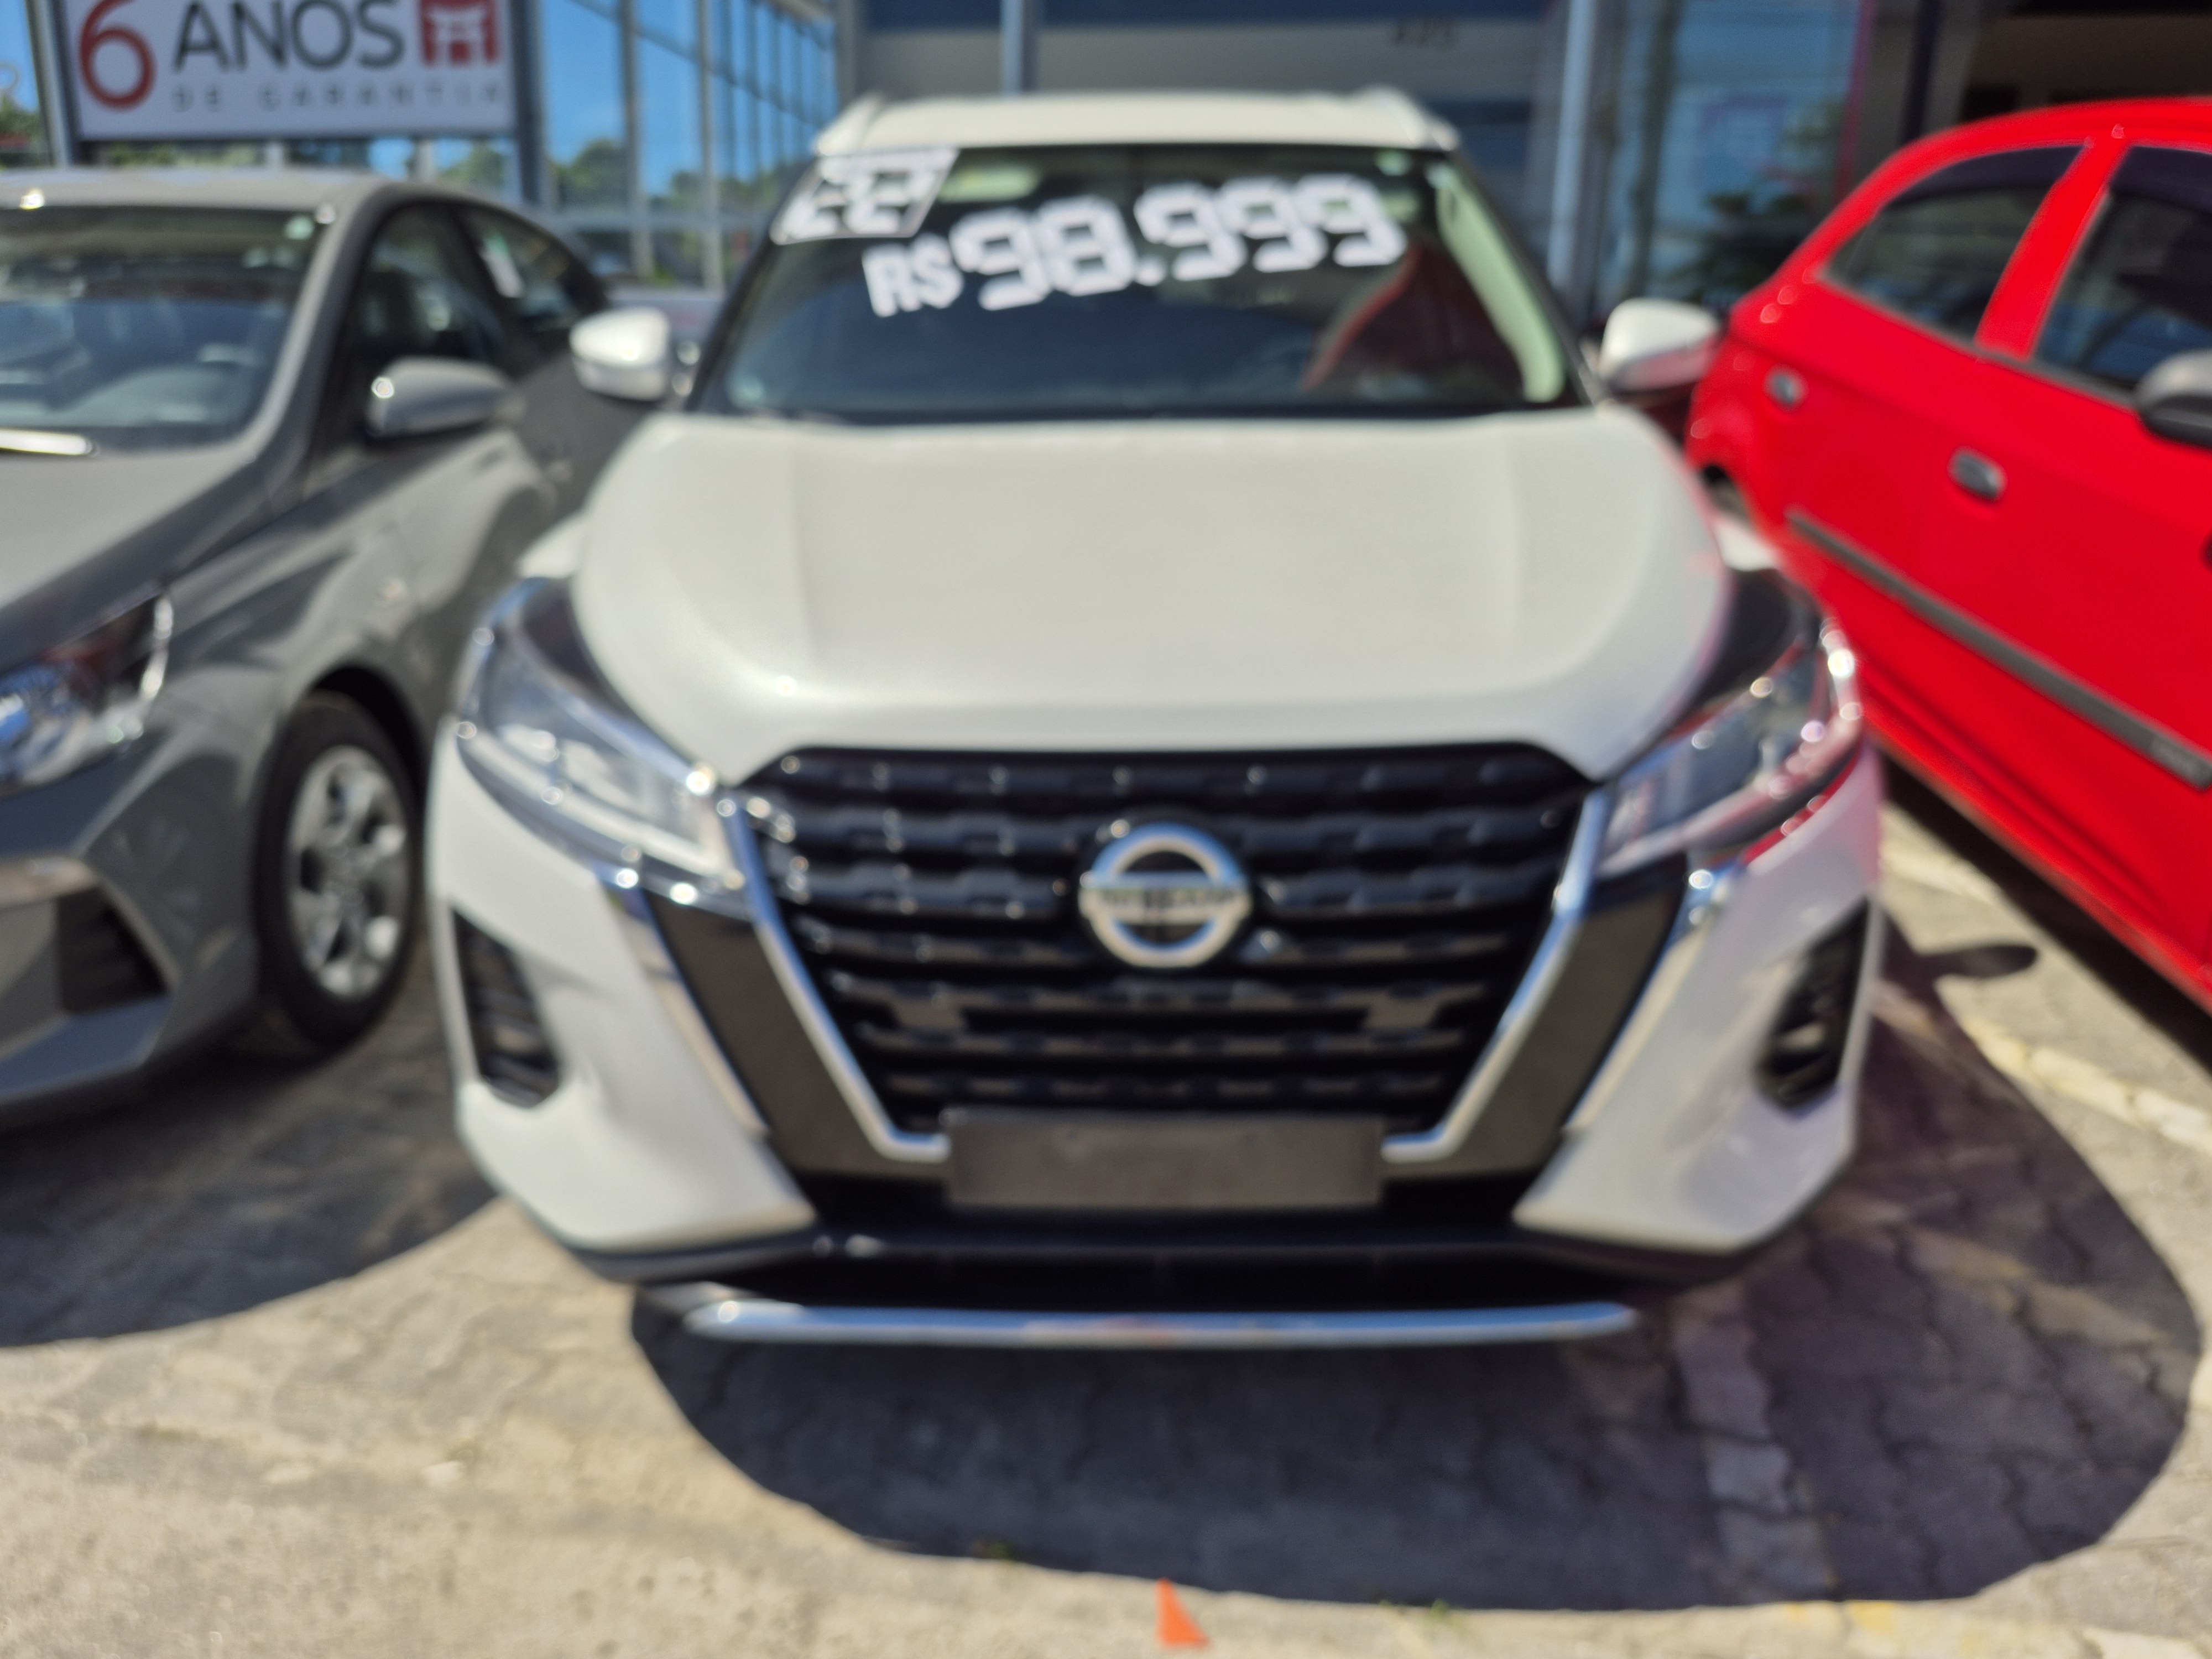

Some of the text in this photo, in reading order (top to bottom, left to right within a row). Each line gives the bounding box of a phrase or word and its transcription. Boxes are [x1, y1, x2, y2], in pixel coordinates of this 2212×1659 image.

[79, 0, 407, 113] 6 ANOS
[947, 173, 1407, 311] 98.999
